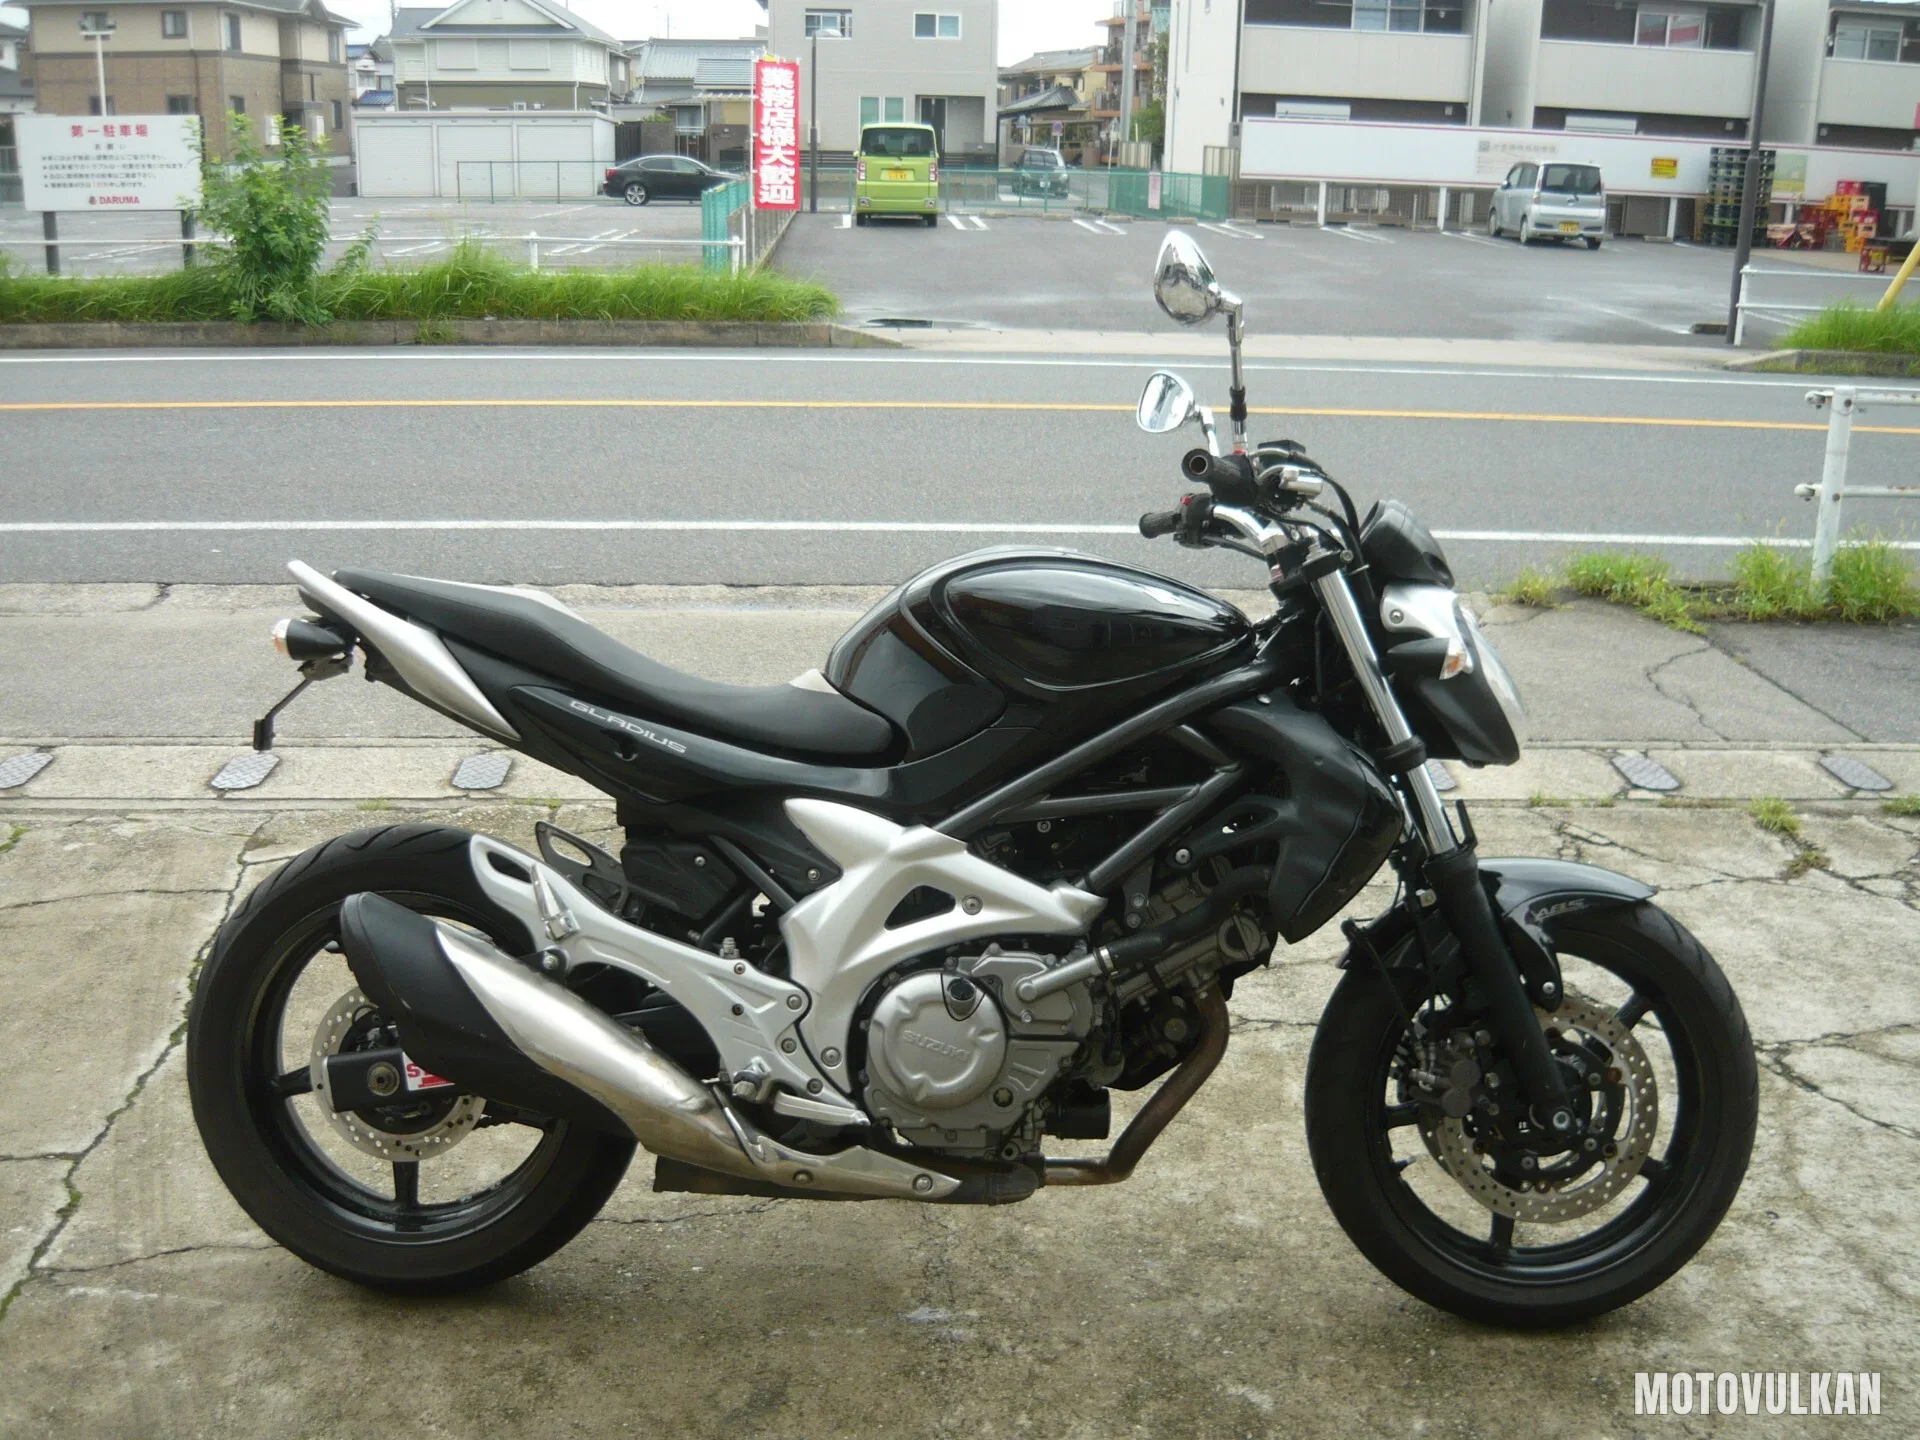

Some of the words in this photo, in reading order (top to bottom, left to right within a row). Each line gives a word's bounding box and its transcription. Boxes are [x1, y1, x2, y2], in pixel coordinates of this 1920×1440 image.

[71, 124, 148, 138] 第一駐車場
[99, 196, 140, 205] DARUMA
[569, 700, 687, 754] GLADIUS
[902, 1029, 971, 1062] SUZUKI
